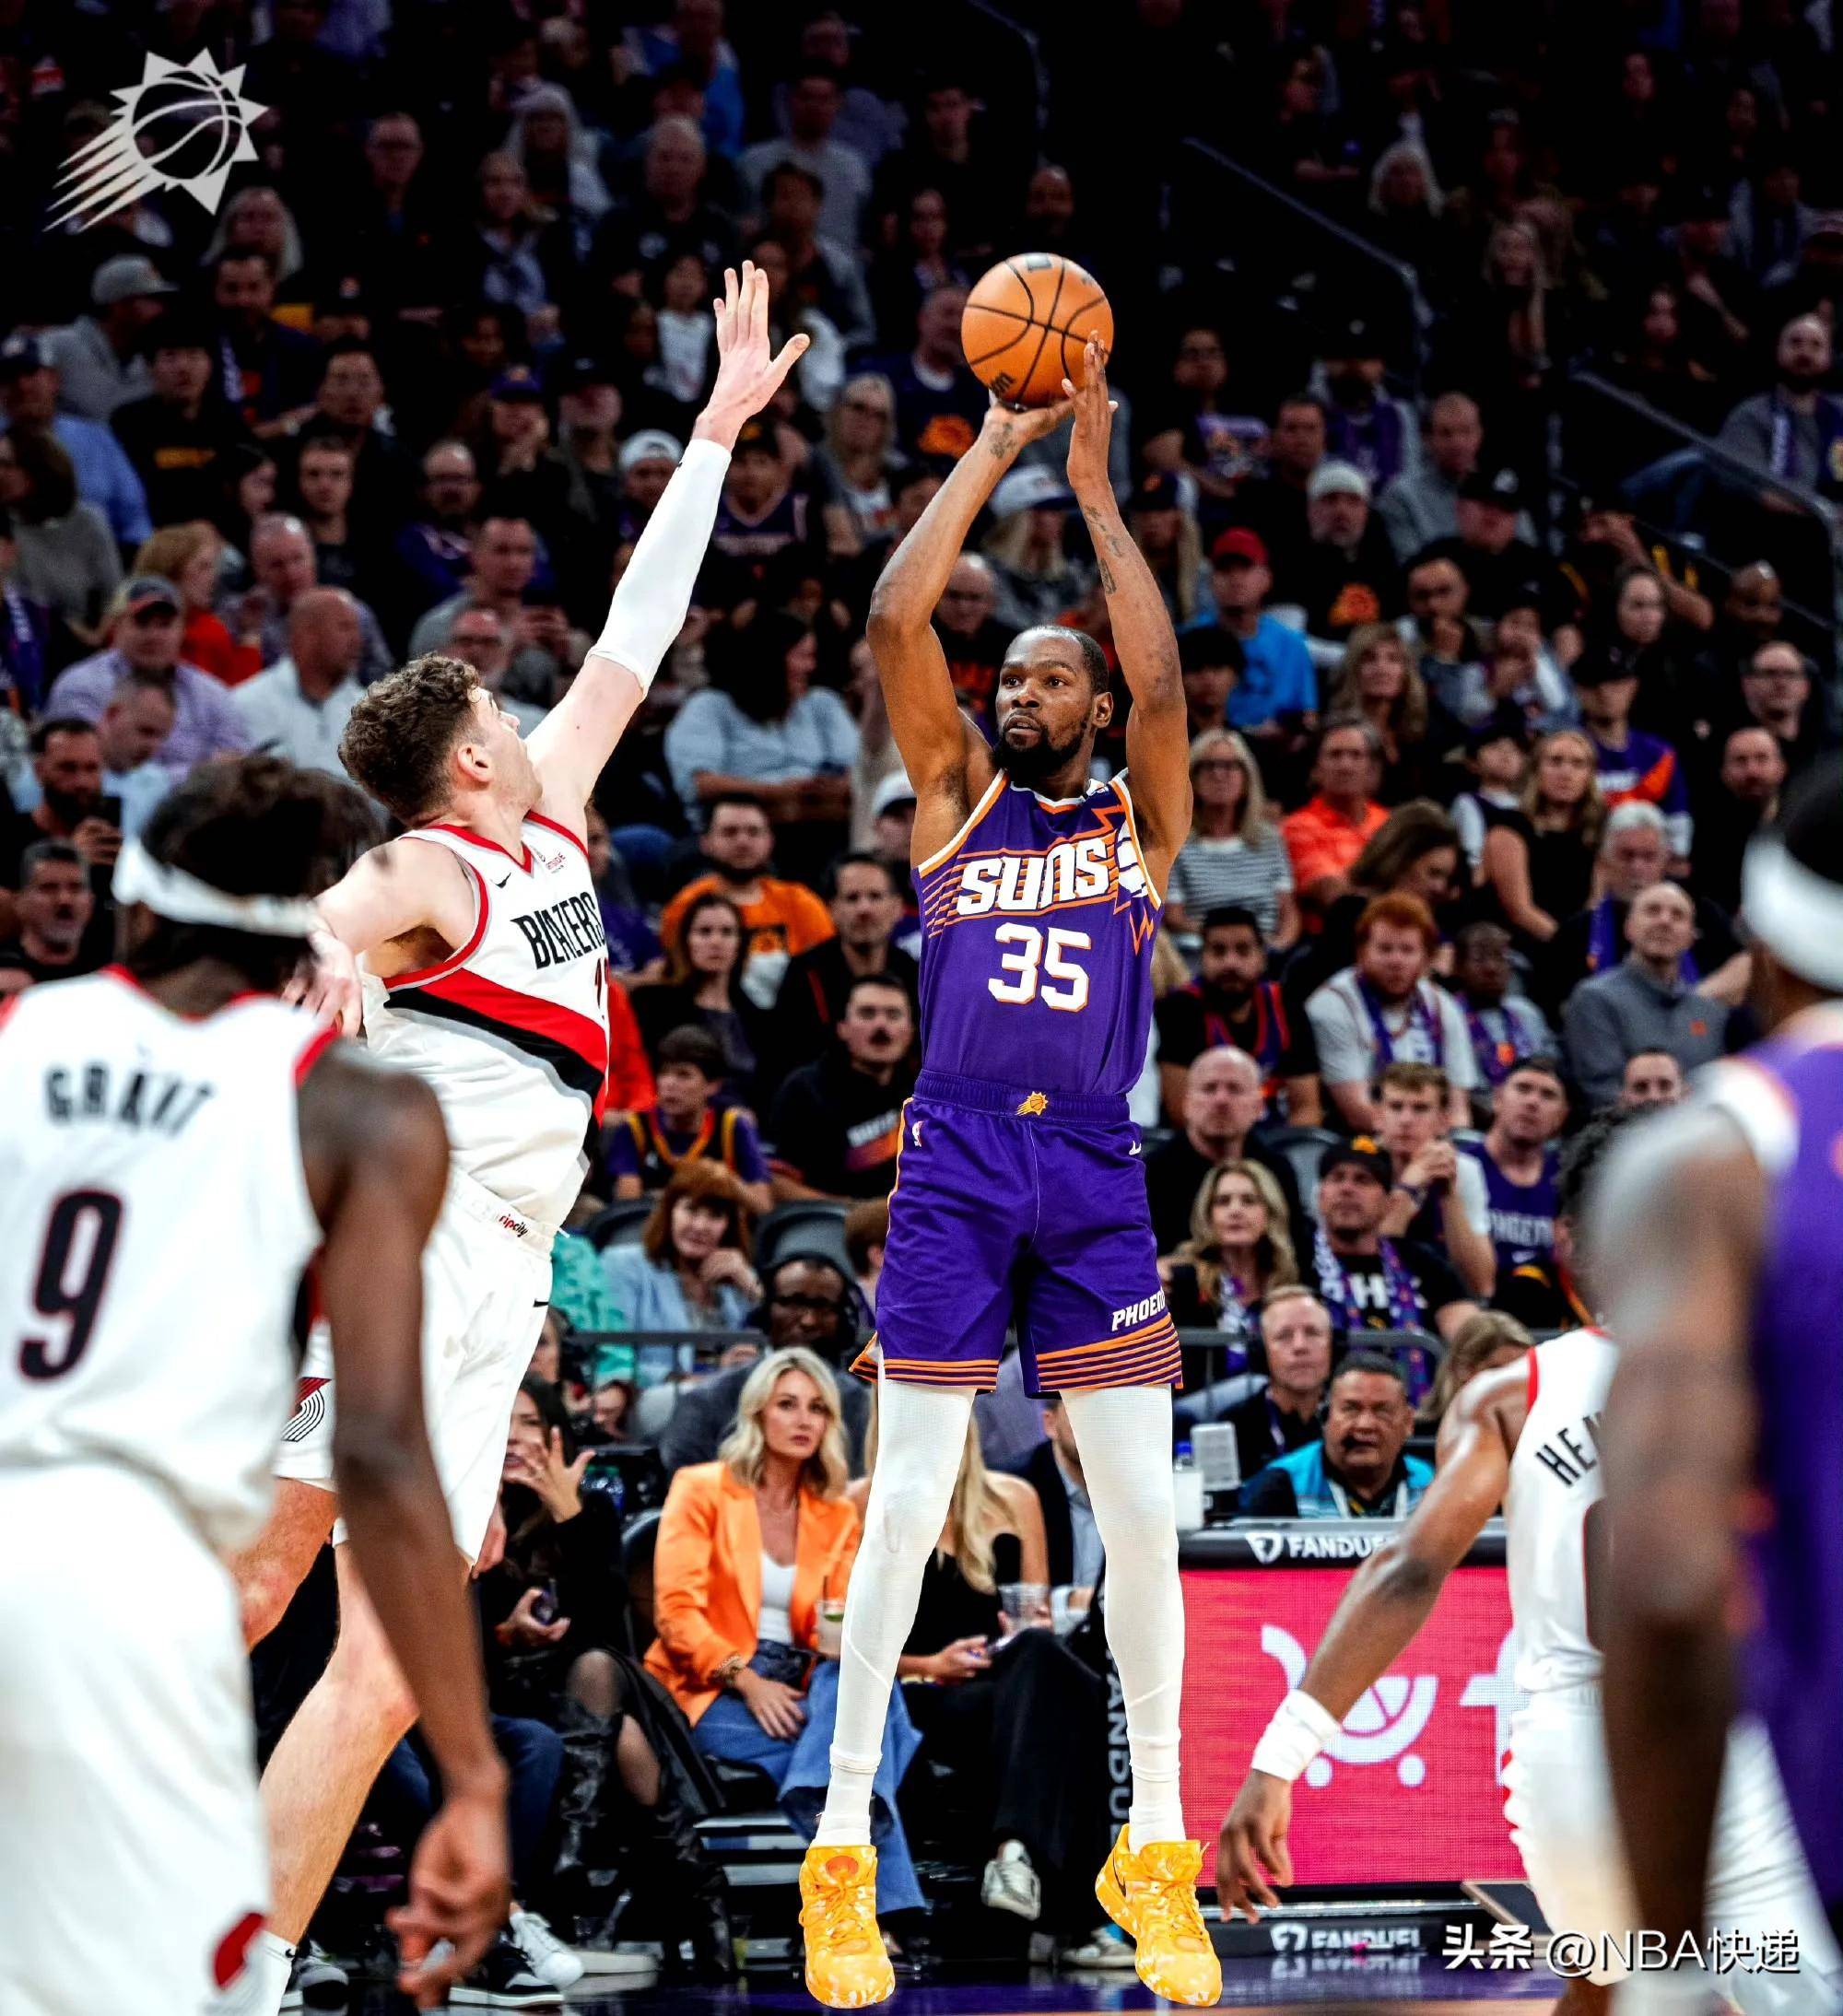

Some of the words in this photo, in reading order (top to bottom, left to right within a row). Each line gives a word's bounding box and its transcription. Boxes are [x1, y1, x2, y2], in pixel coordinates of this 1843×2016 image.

[956, 838, 1109, 916] SUNS
[988, 922, 1091, 1013] 35
[19, 1188, 123, 1379] 9
